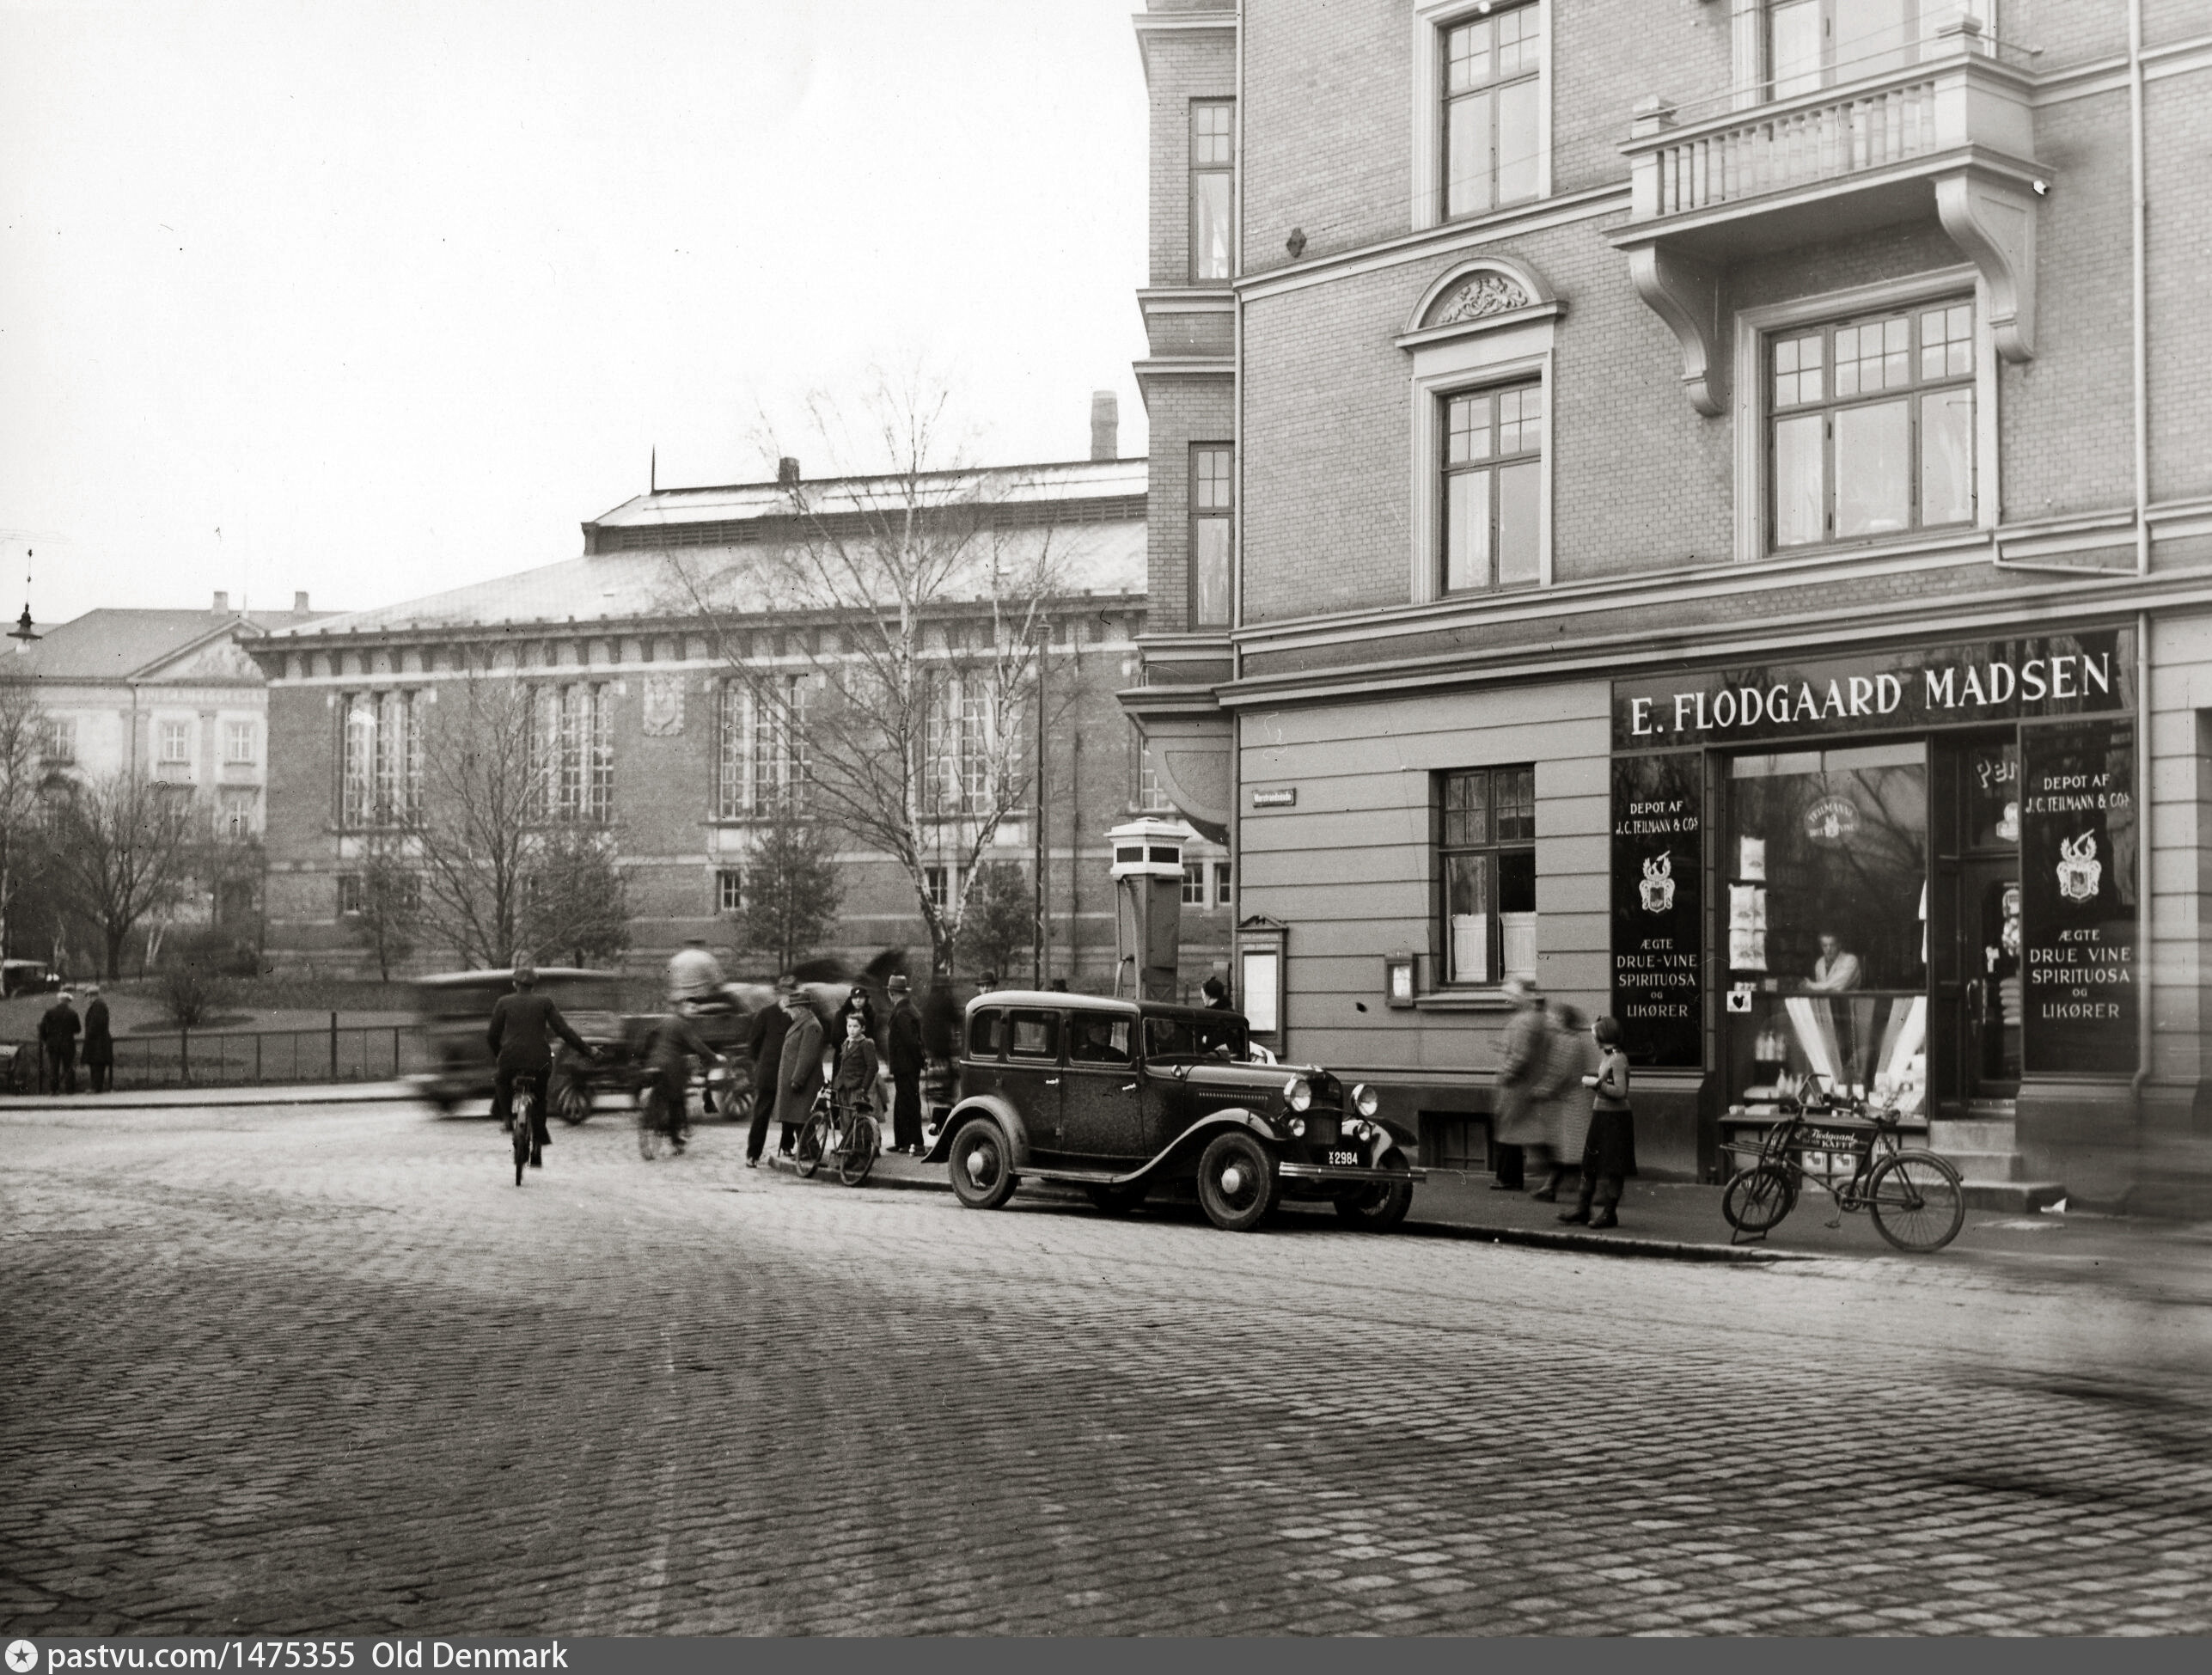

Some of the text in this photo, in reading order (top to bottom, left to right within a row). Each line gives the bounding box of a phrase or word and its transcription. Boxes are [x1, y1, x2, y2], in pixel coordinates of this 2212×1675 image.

[1630, 651, 2110, 736] E. FLODGAARD MADSEN
[2044, 773, 2111, 790] DEPOT AF
[1630, 800, 1684, 816] DEPOT AF
[2048, 794, 2095, 812] TEILMANN
[2098, 793, 2106, 809] &
[1633, 819, 1671, 834] TEILMANN
[1673, 818, 1681, 832] &
[2058, 929, 2100, 942] ÆGTE
[1641, 938, 1673, 950] ÆGTE
[2030, 946, 2131, 963] DRUE VINE
[1618, 973, 1696, 987] SPIRITUOSA
[2032, 968, 2130, 984] SPIRITUOSA
[1627, 1004, 1688, 1018] LIKØRER
[2043, 1003, 2120, 1018] LIKØRER
